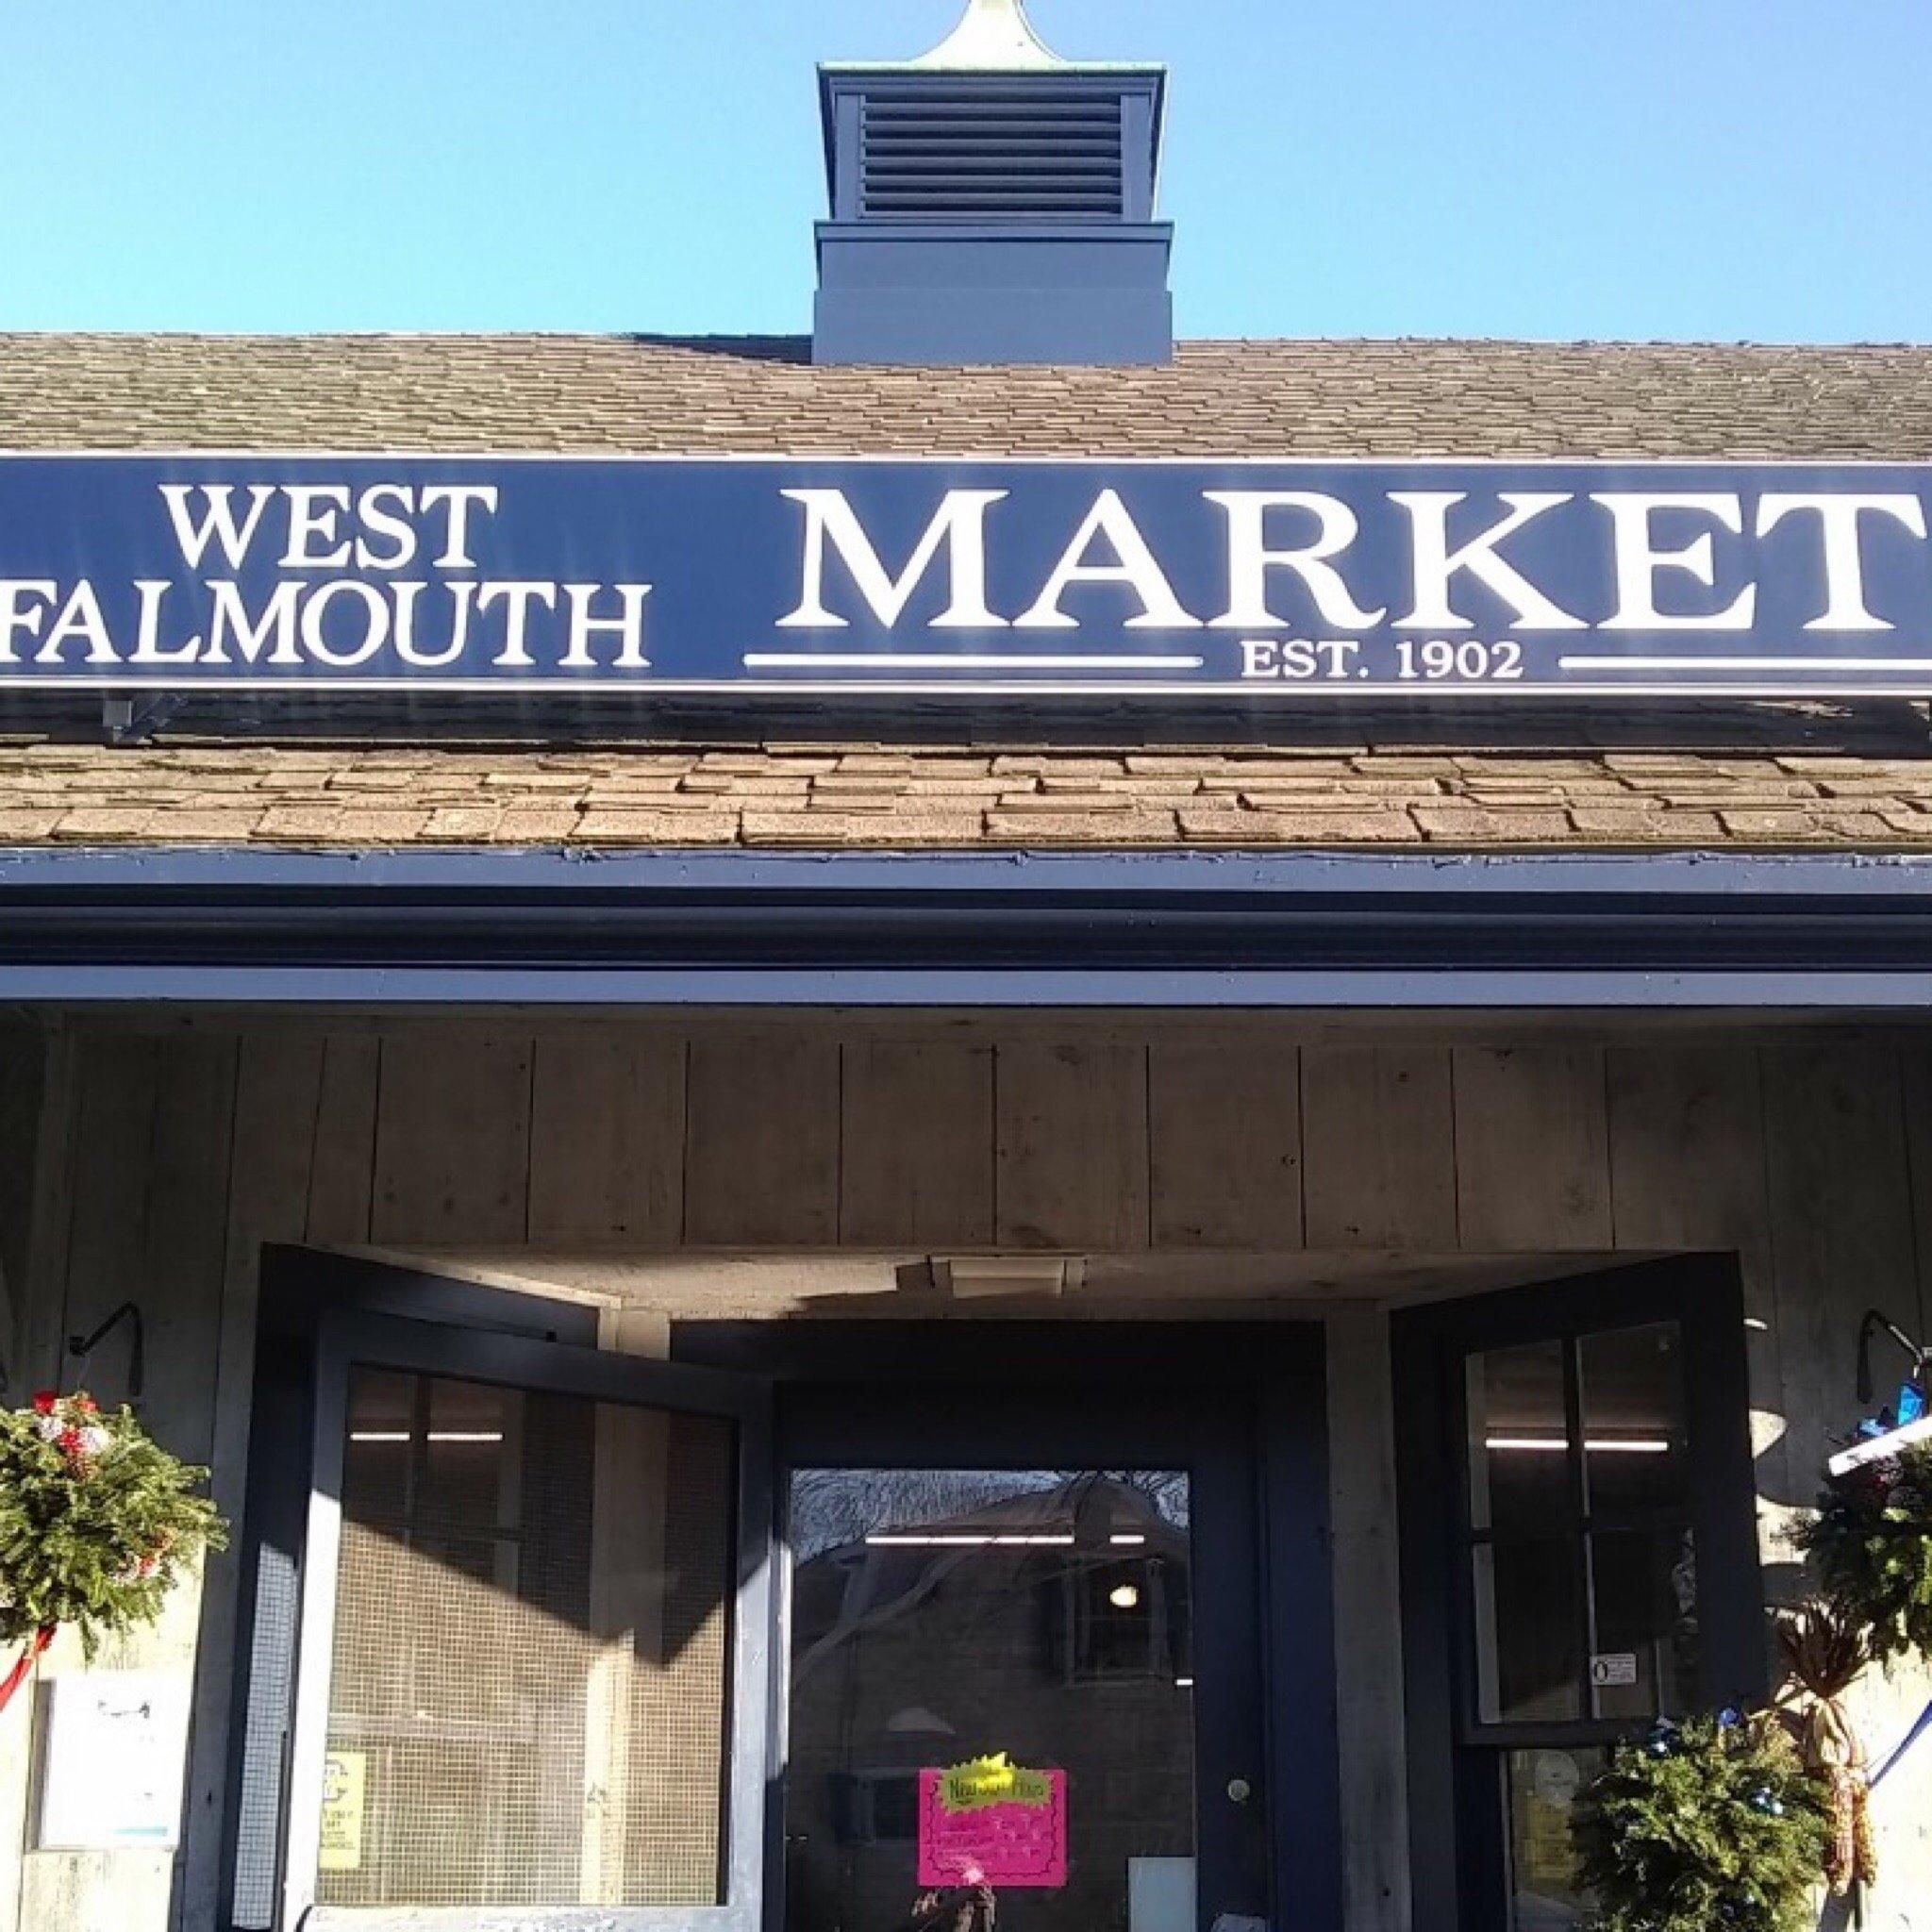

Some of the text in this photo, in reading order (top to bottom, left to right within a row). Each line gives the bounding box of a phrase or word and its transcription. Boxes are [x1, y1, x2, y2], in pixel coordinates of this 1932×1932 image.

[159, 484, 498, 570] WEST
[775, 488, 1927, 634] MARKET
[0, 578, 653, 668] FALMOUTH
[1241, 639, 1524, 679] EST. 1902
